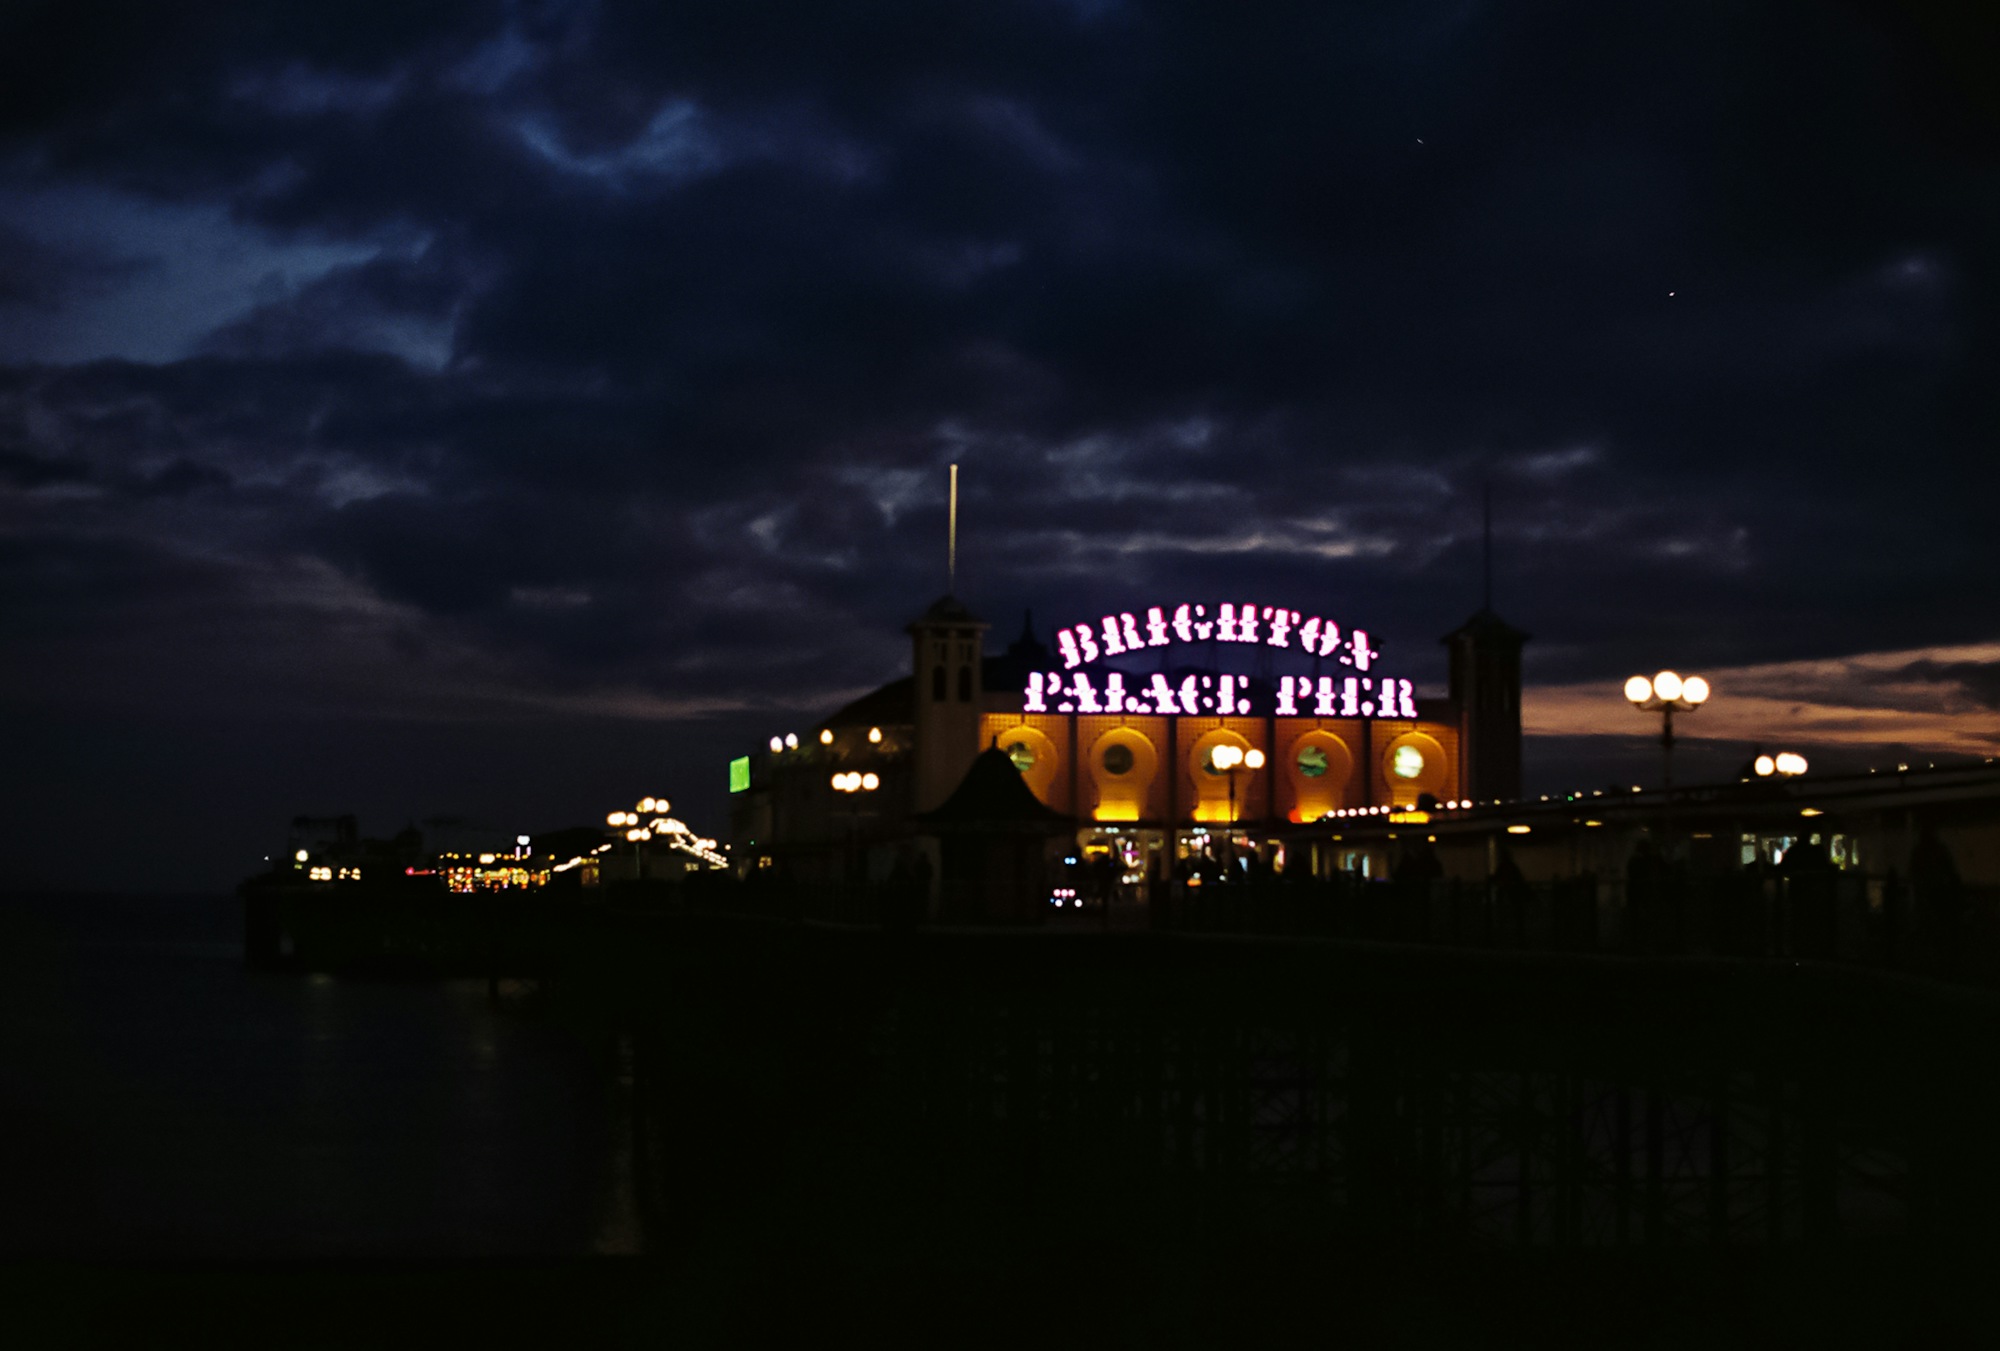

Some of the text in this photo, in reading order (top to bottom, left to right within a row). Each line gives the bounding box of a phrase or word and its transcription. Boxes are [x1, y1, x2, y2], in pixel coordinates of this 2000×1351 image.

[1057, 603, 1379, 671] BRIGHTON
[1023, 671, 1418, 718] PALACE PIER
